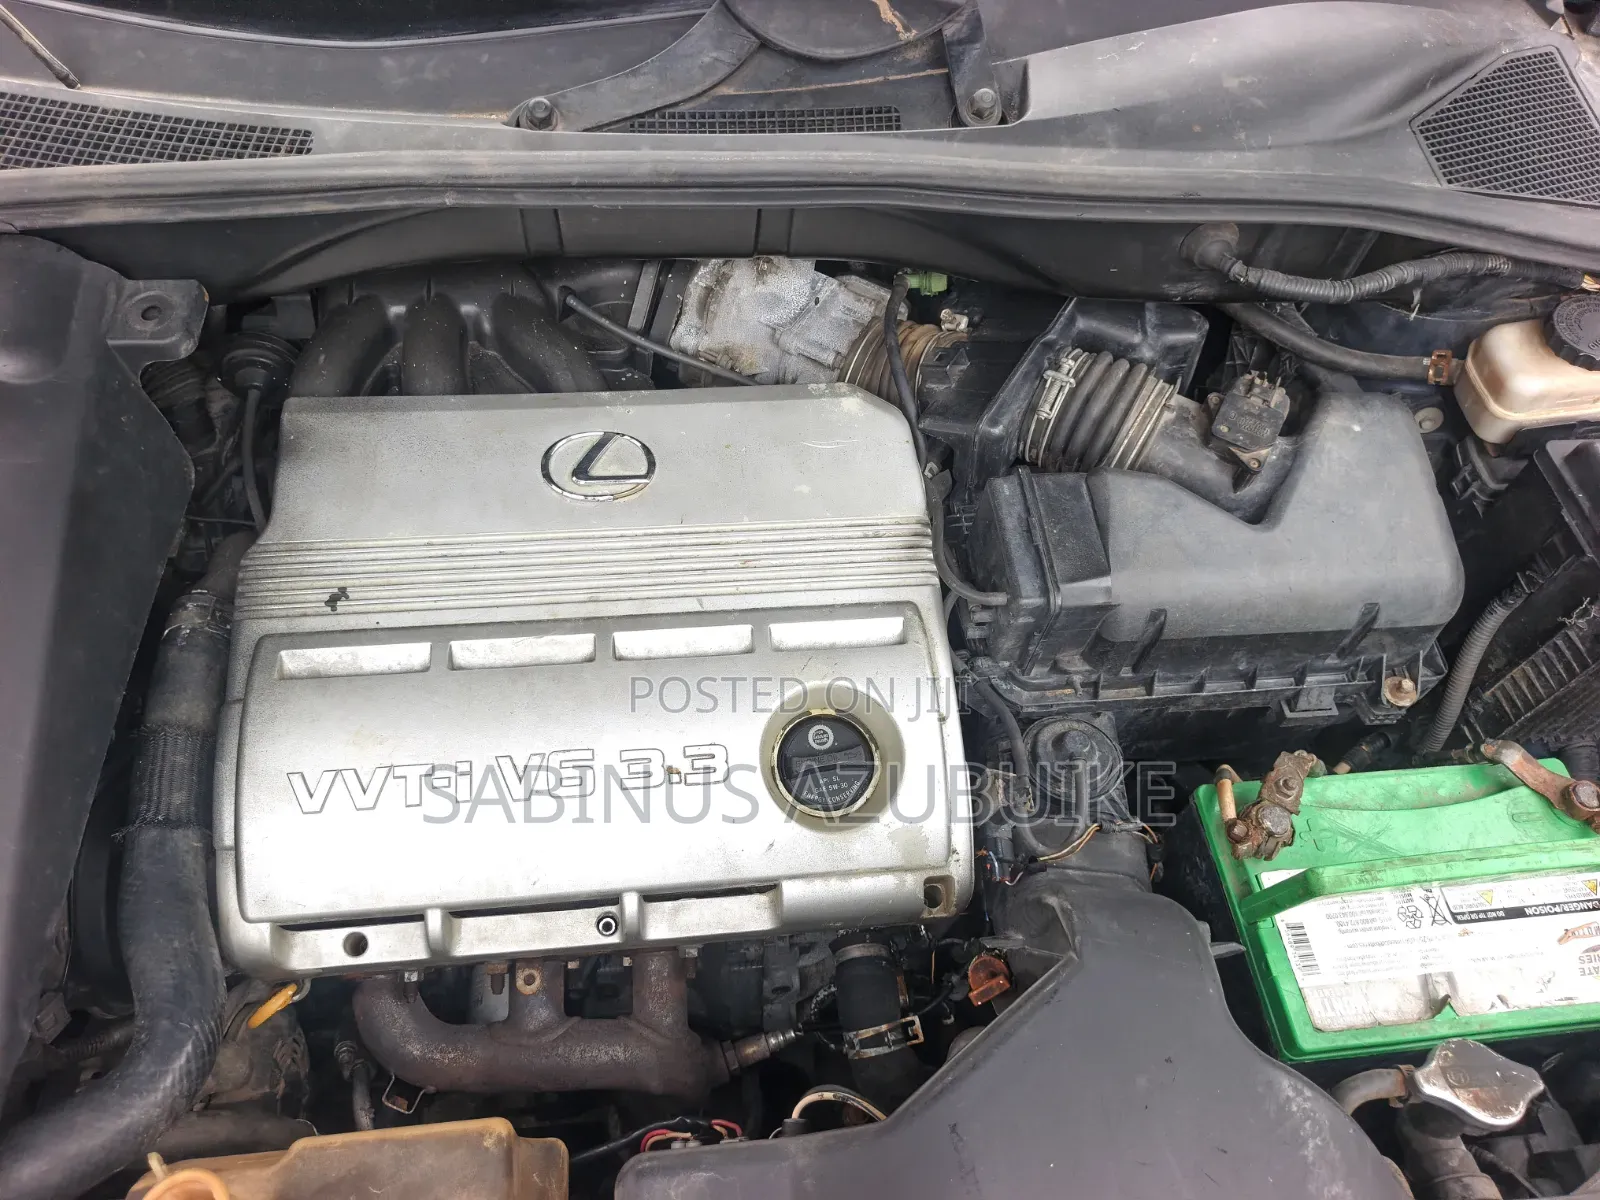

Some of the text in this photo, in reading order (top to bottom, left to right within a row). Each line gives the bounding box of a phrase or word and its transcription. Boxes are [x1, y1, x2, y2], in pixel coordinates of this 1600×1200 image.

[495, 748, 596, 802] V6
[619, 742, 730, 791] 3.3
[827, 780, 860, 803] CONSERVING
[828, 782, 848, 791] 5W-30
[1524, 900, 1600, 916] DANGER/POISON
